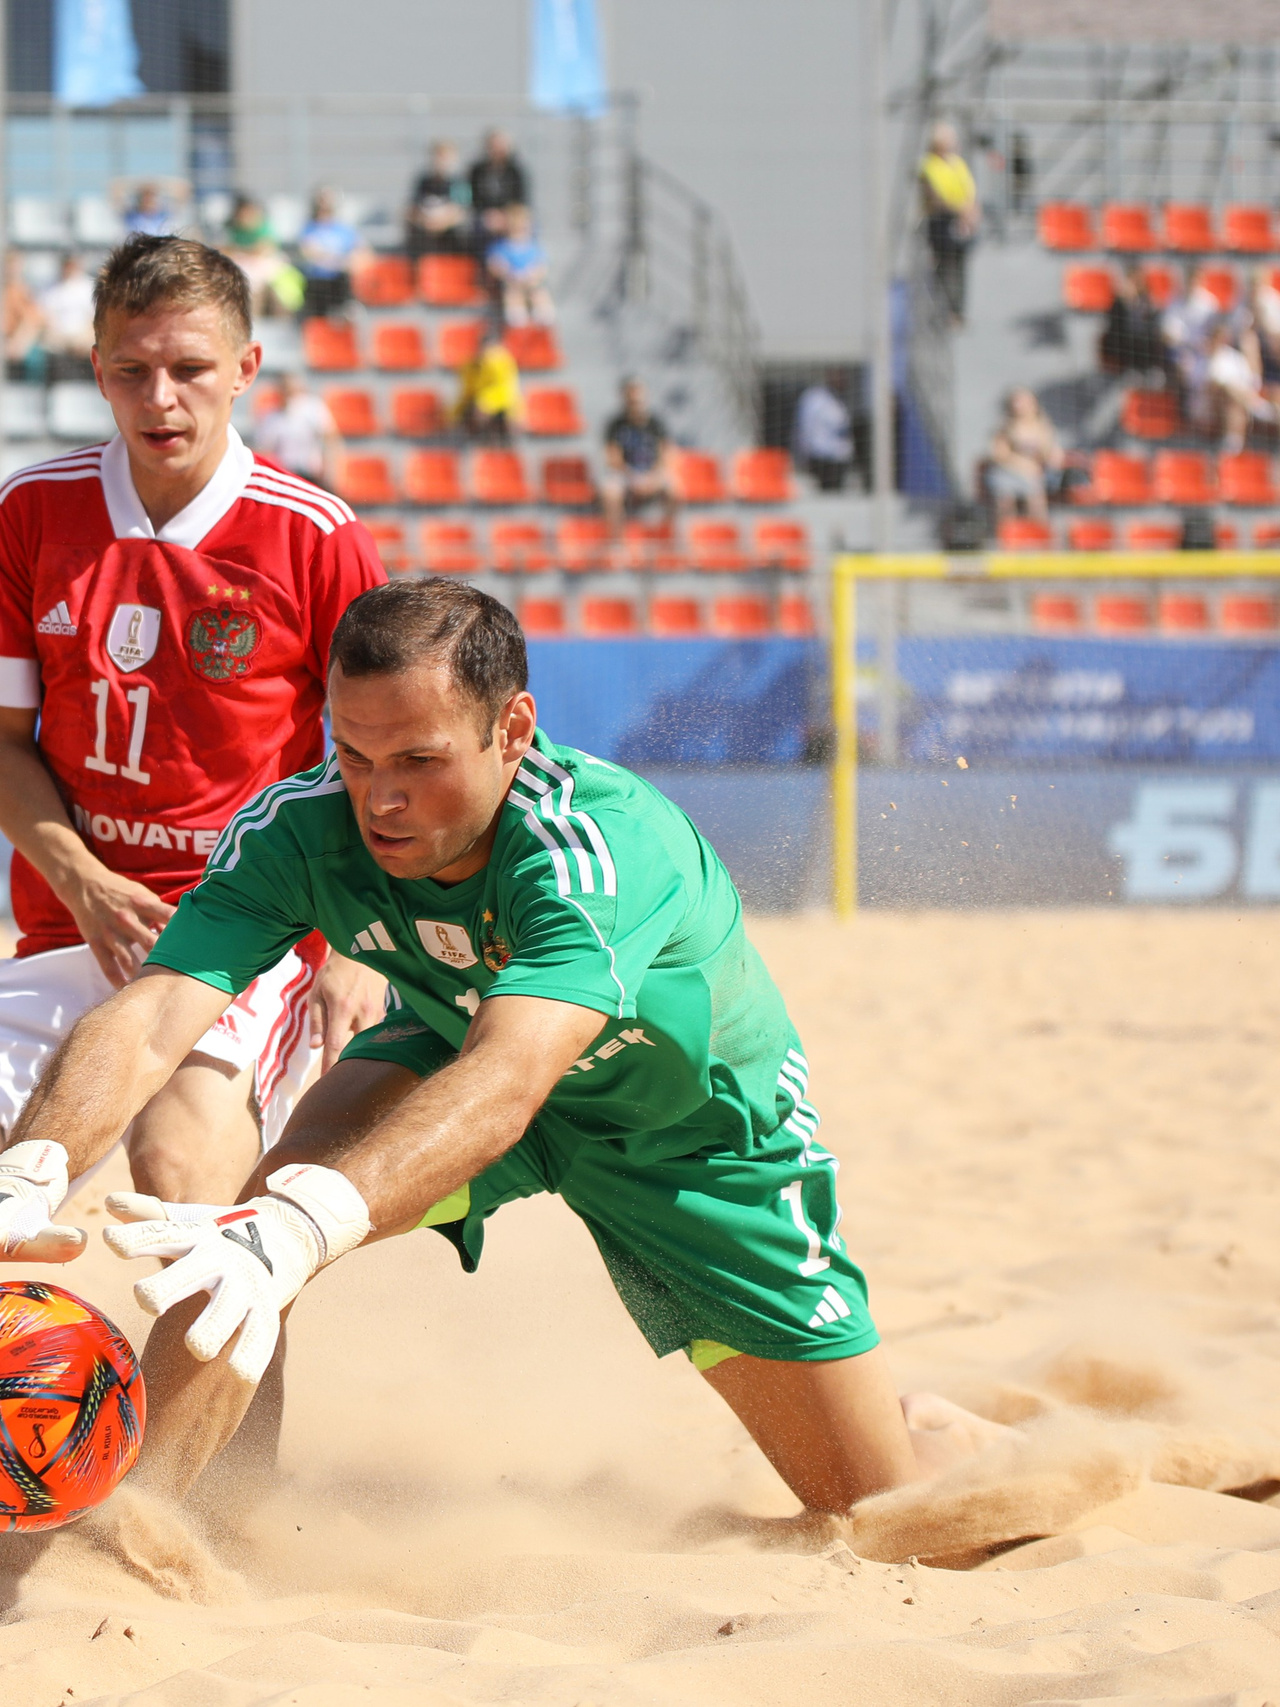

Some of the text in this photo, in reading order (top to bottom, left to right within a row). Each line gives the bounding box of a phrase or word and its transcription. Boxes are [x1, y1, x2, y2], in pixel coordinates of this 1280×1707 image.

[38, 621, 77, 635] adidas
[120, 646, 141, 656] FIFA
[85, 679, 150, 785] 11
[563, 1028, 657, 1076] TEK
[780, 1180, 831, 1278] 1
